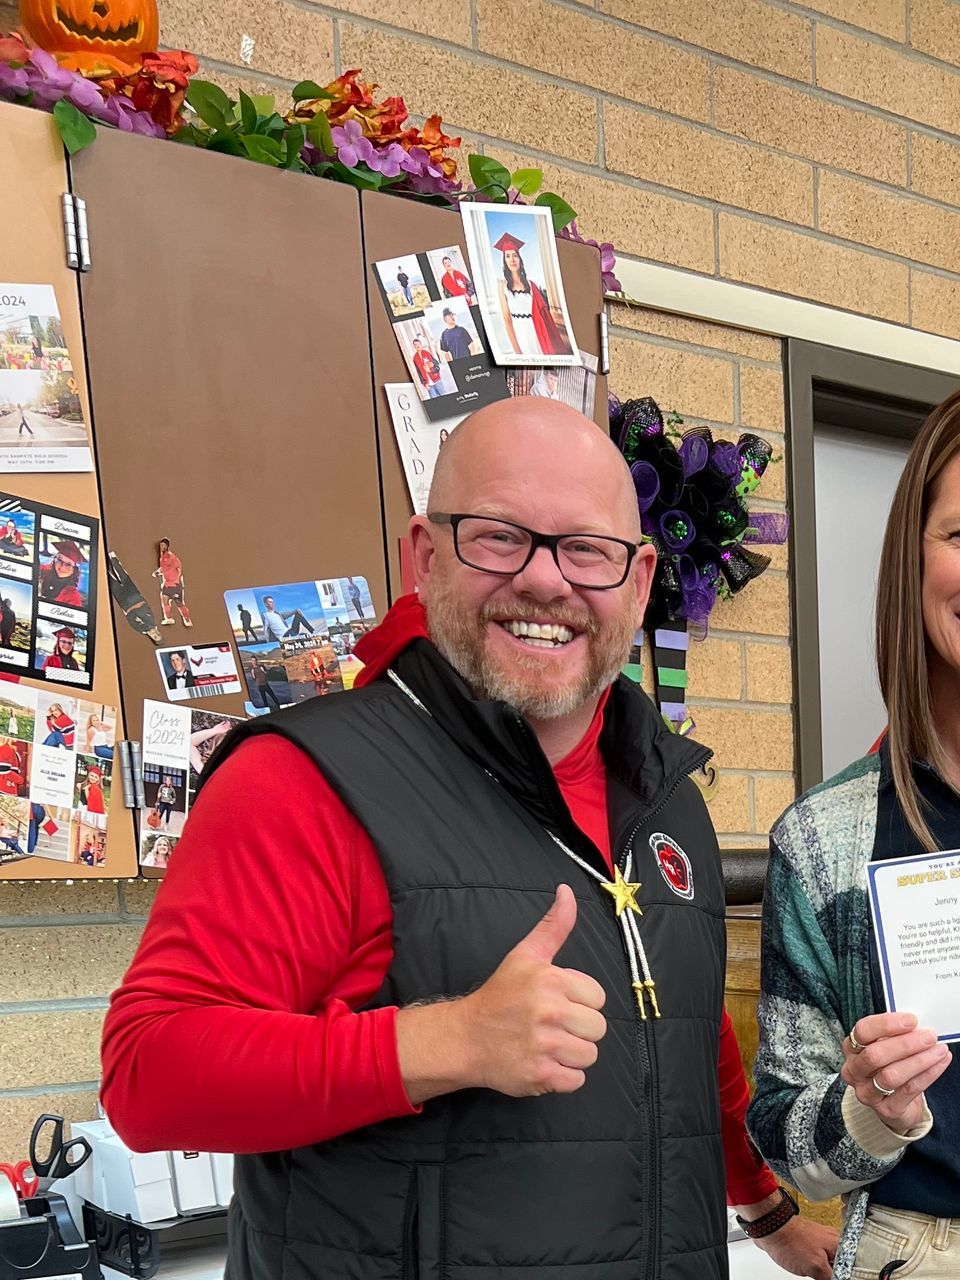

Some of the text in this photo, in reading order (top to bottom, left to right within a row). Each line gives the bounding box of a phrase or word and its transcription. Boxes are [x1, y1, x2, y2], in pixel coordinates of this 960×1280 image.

[0, 295, 26, 307] 024
[897, 870, 947, 887] SUPER
[933, 895, 958, 907] Jenny
[903, 923, 916, 931] You
[929, 919, 945, 927] such
[897, 931, 917, 940] You're
[900, 939, 924, 950] friendly
[903, 950, 921, 958] never
[936, 945, 959, 955] anyone
[901, 957, 927, 967] thankful
[928, 954, 947, 965] you're
[935, 972, 952, 980] From
